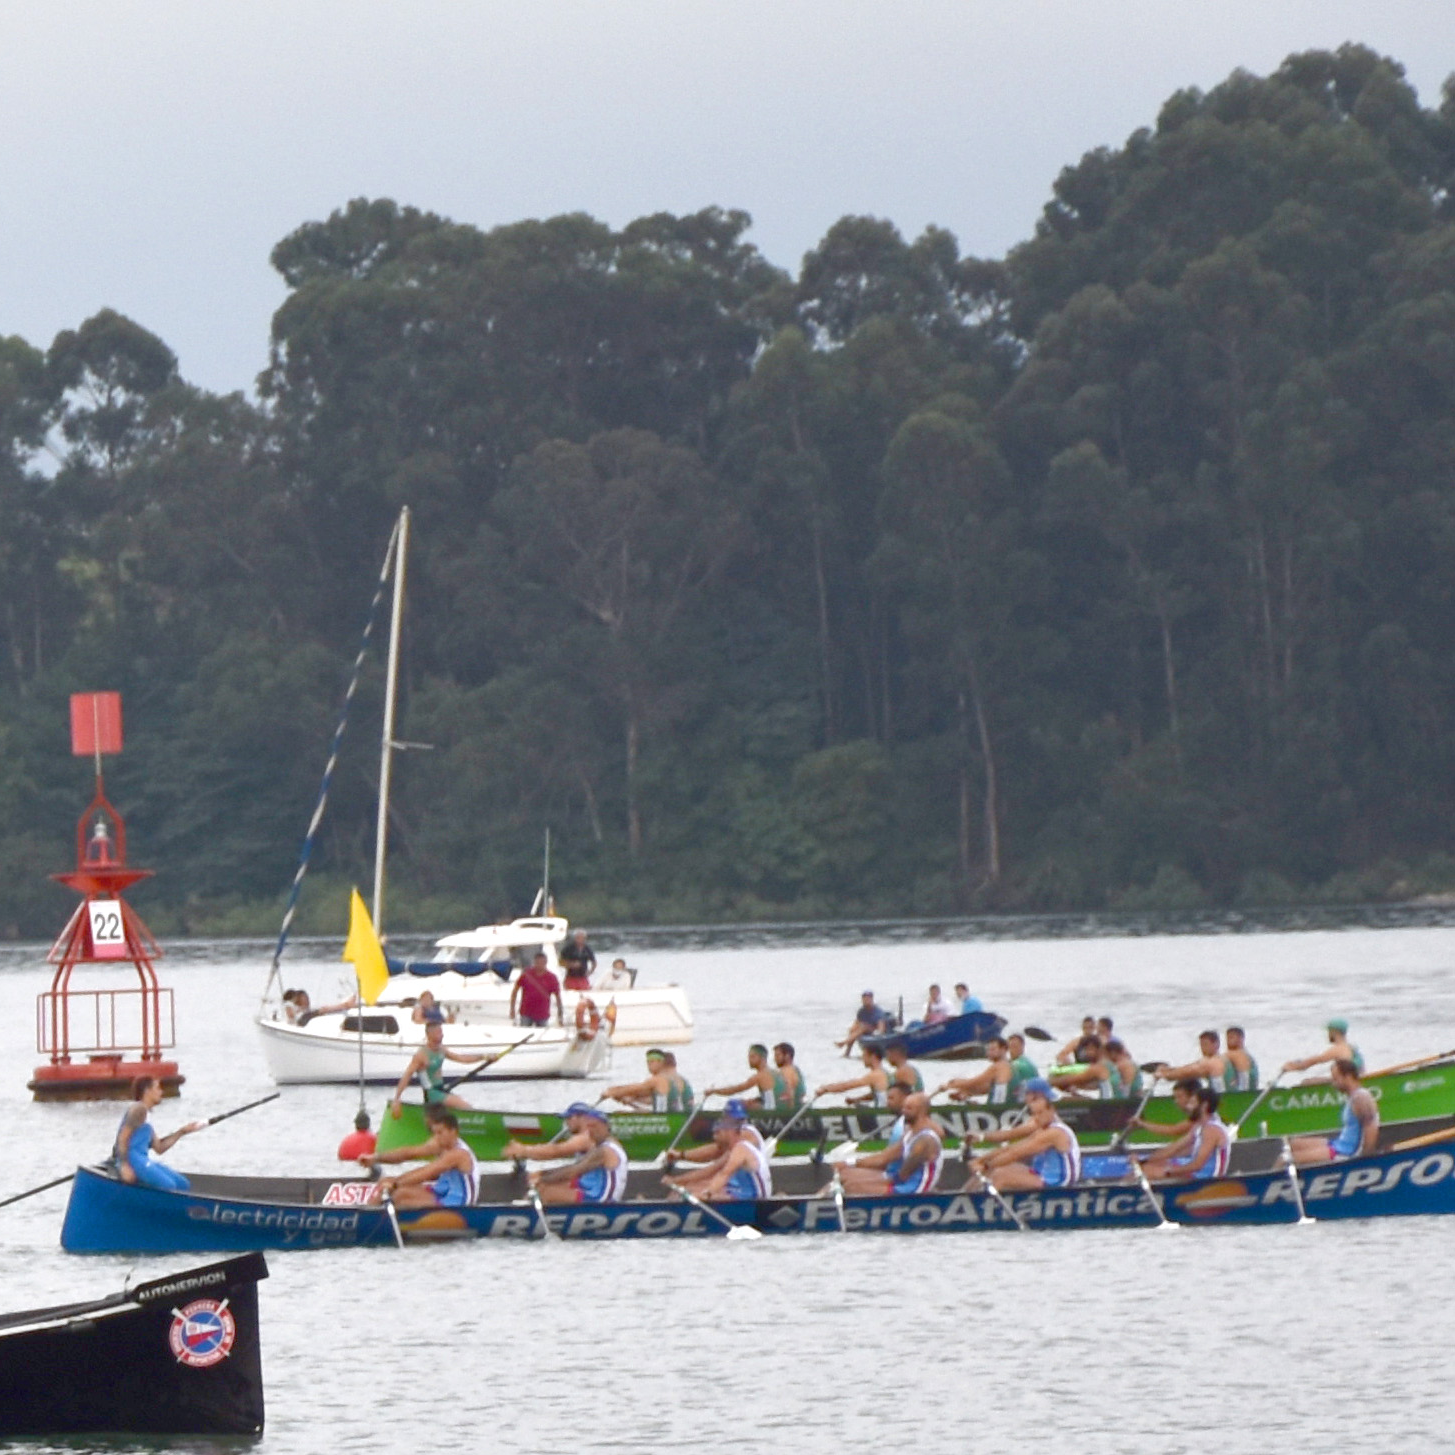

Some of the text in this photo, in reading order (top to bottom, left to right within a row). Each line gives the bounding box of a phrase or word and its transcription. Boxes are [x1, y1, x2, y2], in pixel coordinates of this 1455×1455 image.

[93, 913, 121, 940] 22
[1270, 1086, 1382, 1111] CAMAO
[1261, 1153, 1455, 1206] REPSO
[322, 1182, 377, 1206] AST
[491, 1210, 709, 1237] REPSOL
